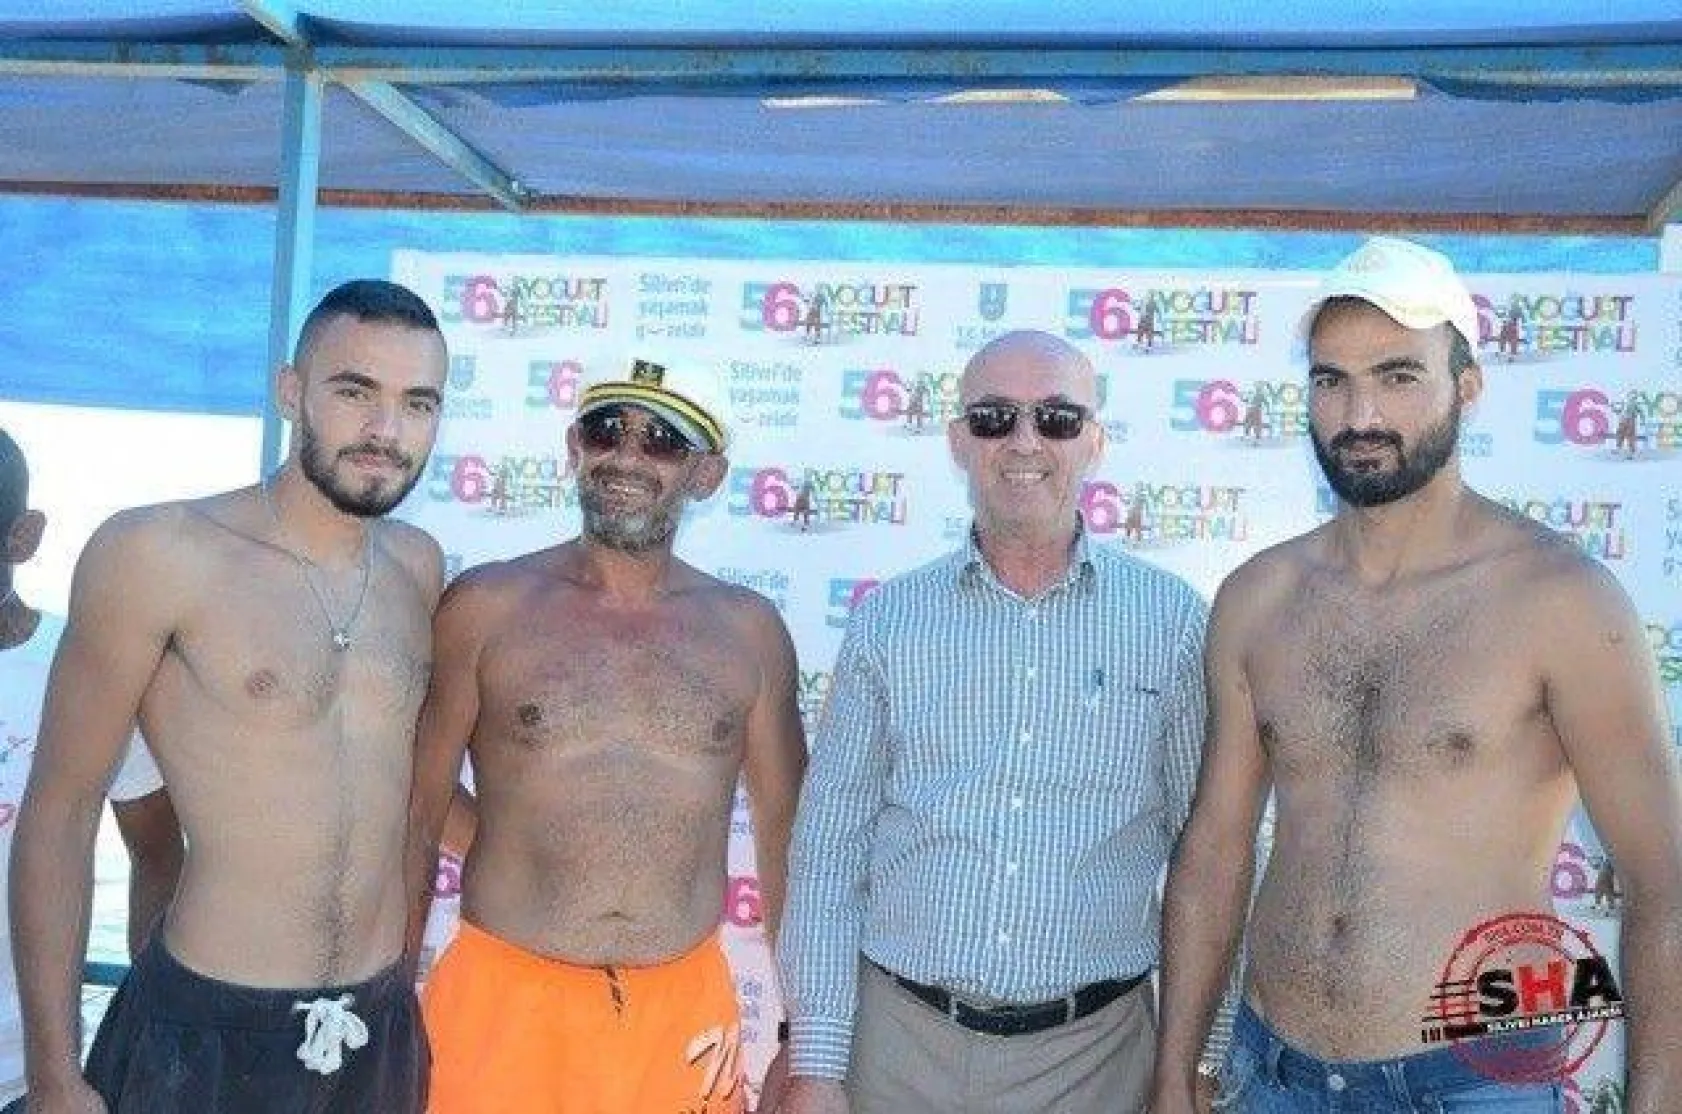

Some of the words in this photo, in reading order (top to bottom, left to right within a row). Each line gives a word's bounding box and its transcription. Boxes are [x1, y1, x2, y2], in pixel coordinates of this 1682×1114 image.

[442, 275, 497, 323] 56
[739, 281, 799, 332] 56
[1065, 288, 1131, 340] 56
[839, 370, 900, 420] 56
[1171, 380, 1239, 432] 56
[1534, 388, 1609, 444] 56
[427, 455, 486, 503] 56
[727, 468, 789, 518] 56
[825, 577, 879, 629] 5
